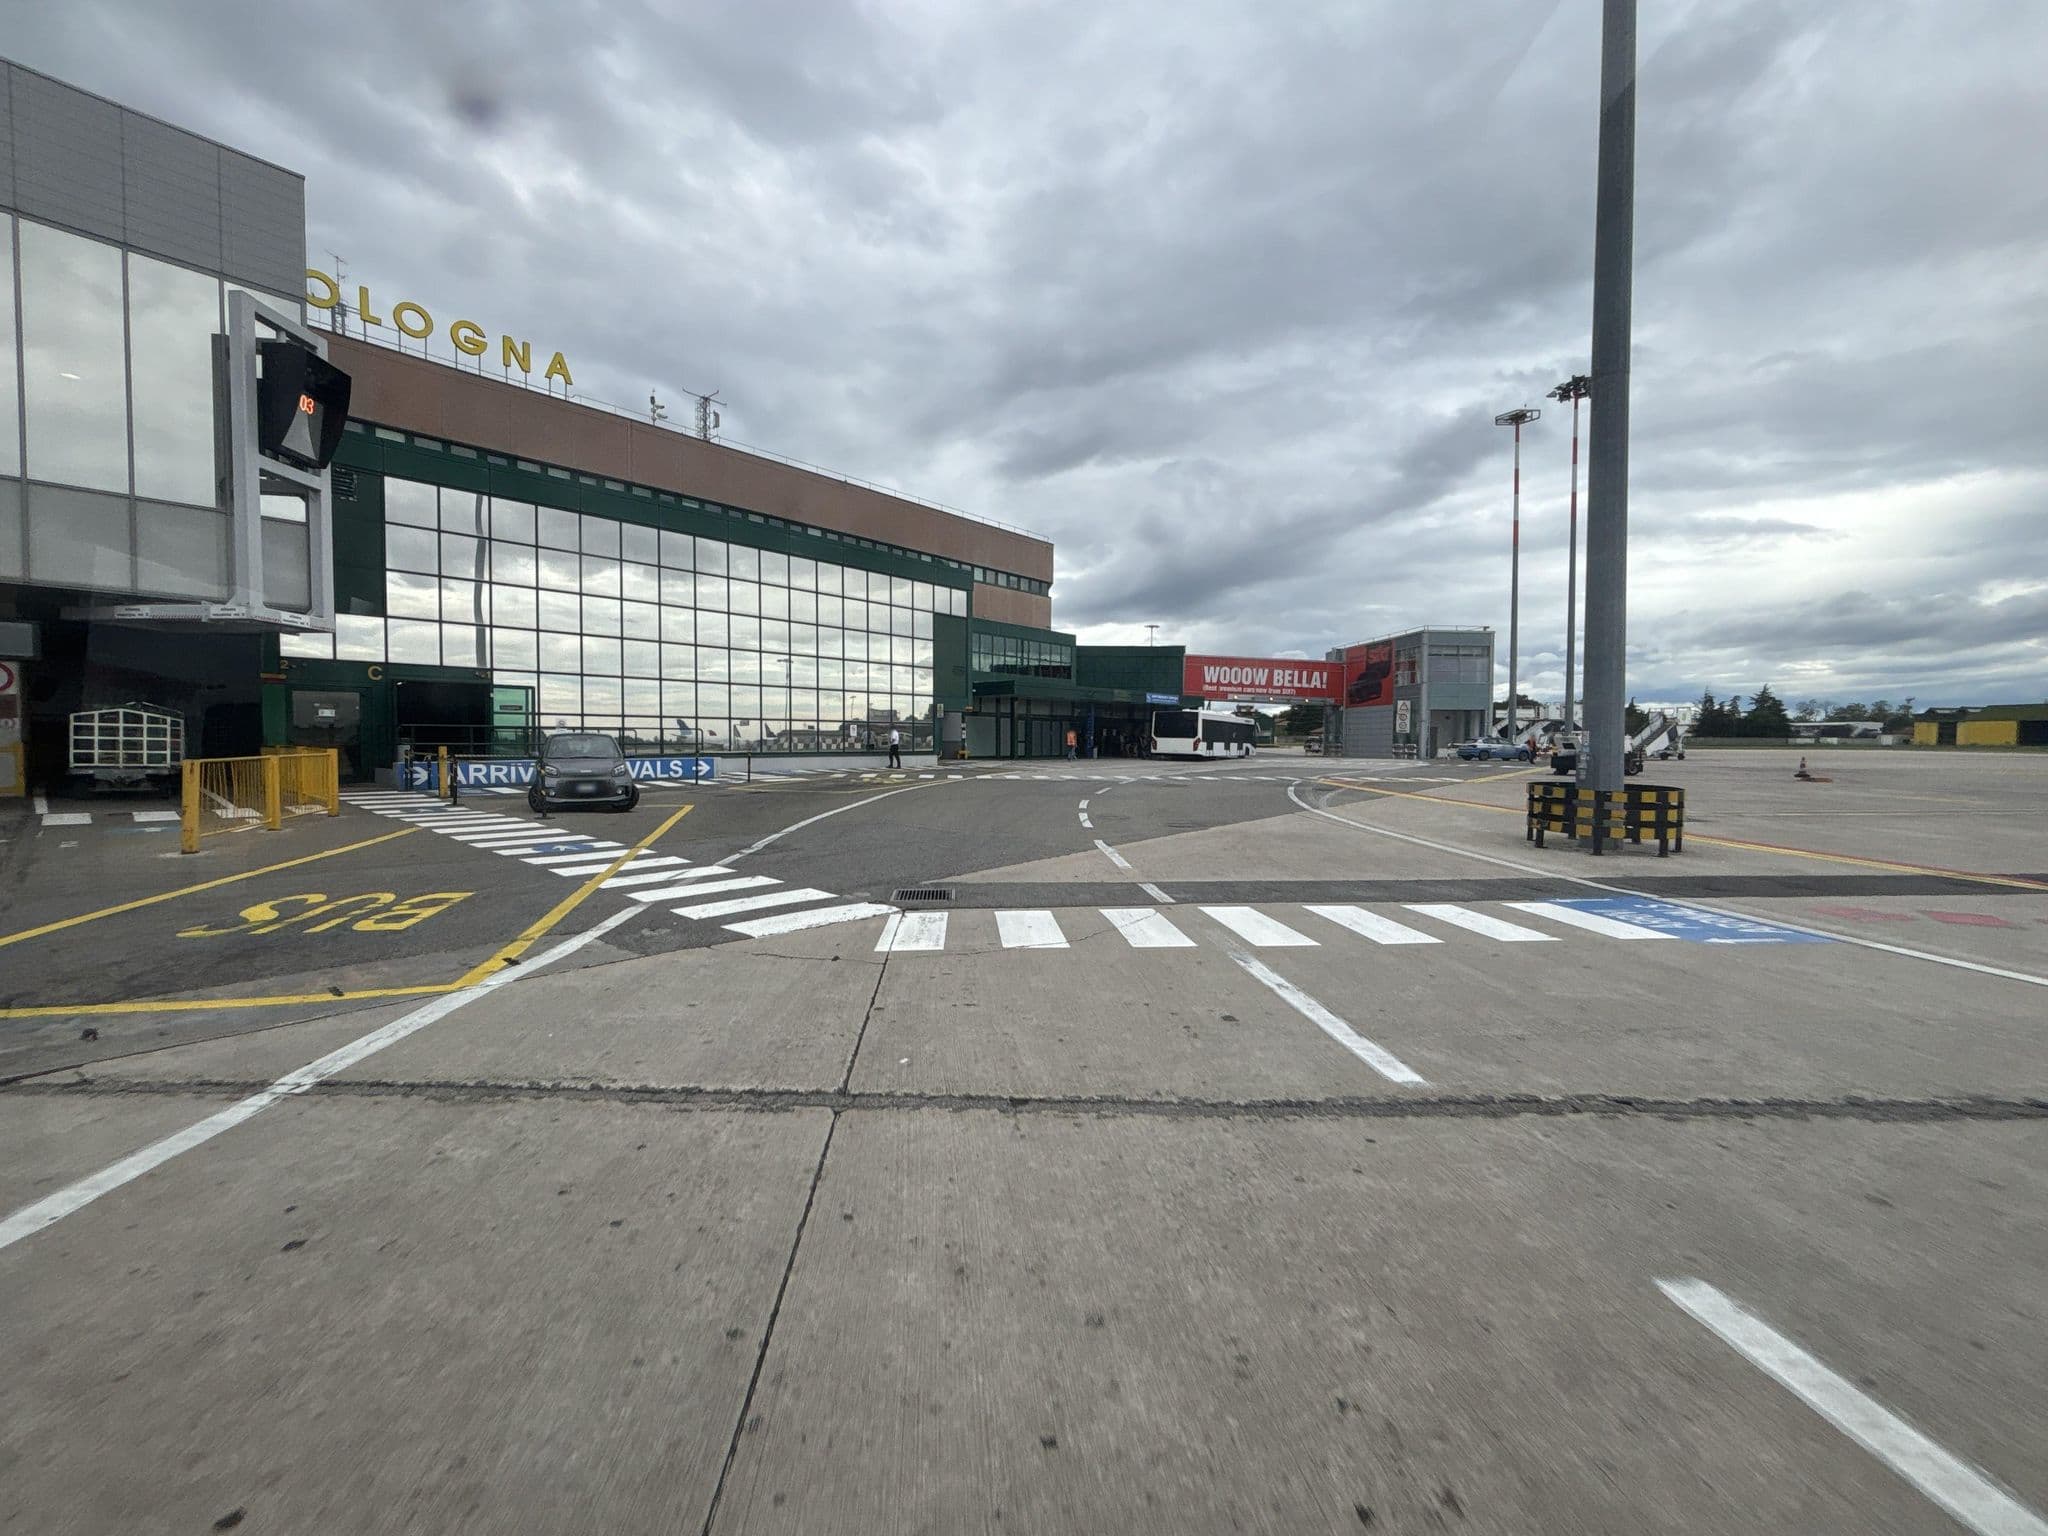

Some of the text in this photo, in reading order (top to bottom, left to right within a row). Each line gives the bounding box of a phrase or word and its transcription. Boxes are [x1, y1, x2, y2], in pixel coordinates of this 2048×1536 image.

[305, 268, 573, 386] OLOGNA
[300, 394, 314, 415] 03
[367, 665, 383, 681] C
[1203, 665, 1328, 689] WOOOW BELLA!
[448, 760, 684, 785] ARRIV VALS
[175, 892, 475, 938] BUS
